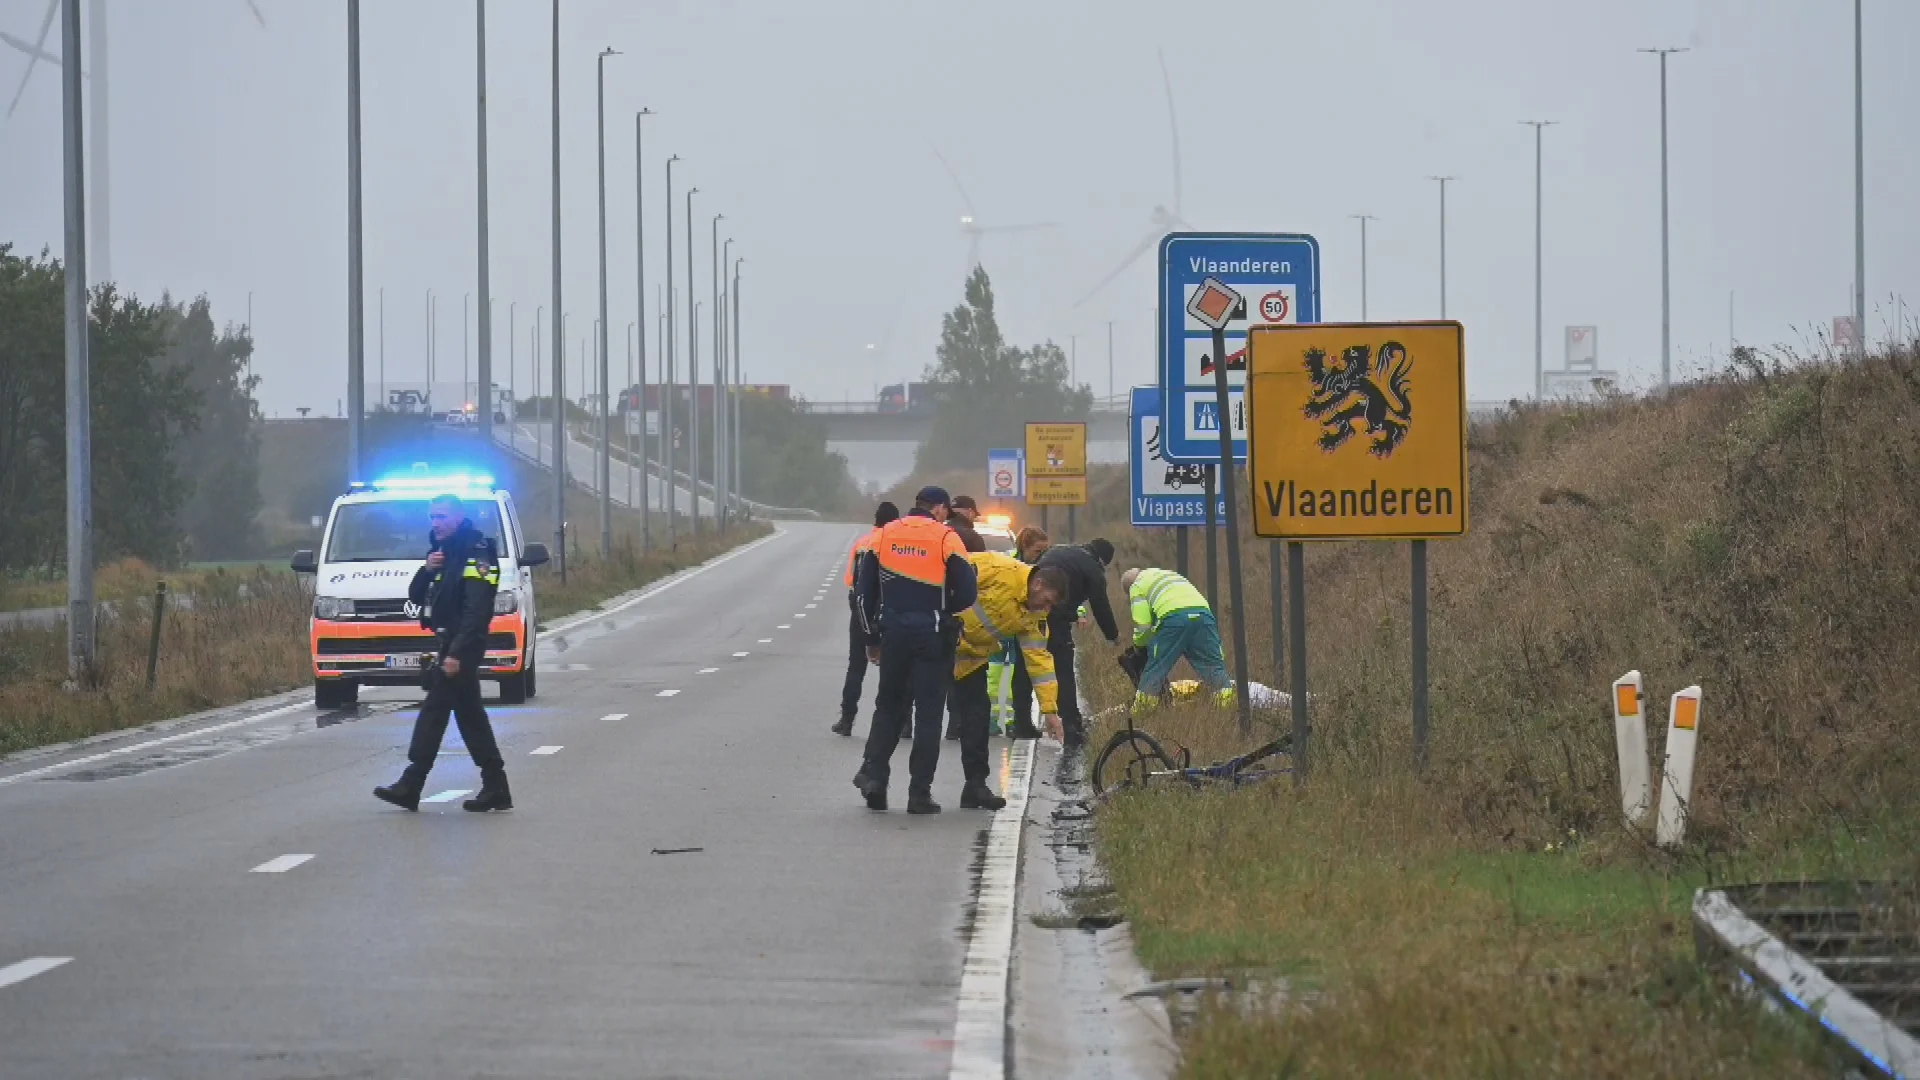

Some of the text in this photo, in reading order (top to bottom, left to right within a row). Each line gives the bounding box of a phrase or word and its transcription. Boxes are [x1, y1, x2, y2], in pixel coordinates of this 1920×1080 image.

[1189, 257, 1291, 273] Vlaanderen
[1265, 301, 1283, 314] 50
[1263, 479, 1453, 517] Vlaanderen
[1137, 497, 1226, 520] Viapass.e
[891, 543, 927, 557] Politie
[352, 569, 409, 579] Politie
